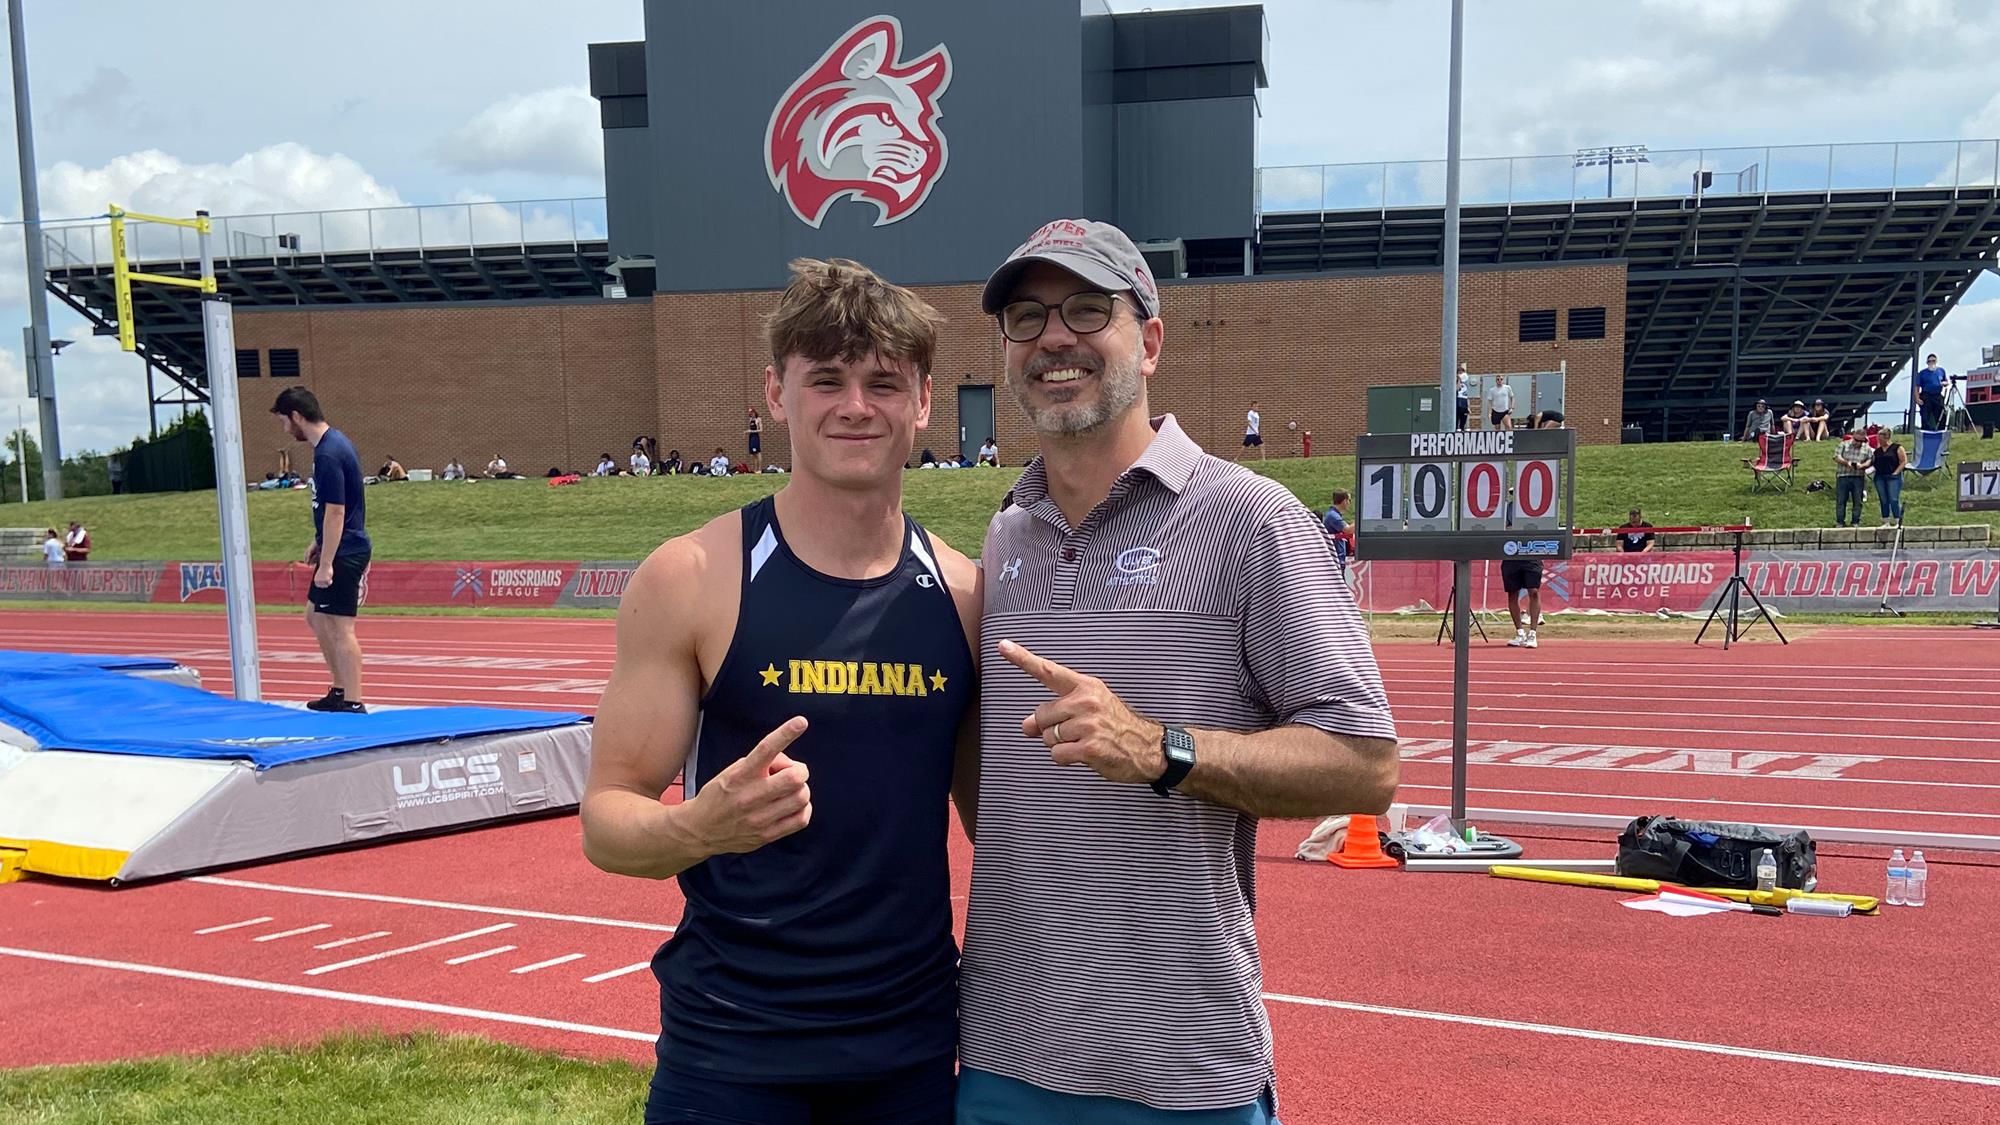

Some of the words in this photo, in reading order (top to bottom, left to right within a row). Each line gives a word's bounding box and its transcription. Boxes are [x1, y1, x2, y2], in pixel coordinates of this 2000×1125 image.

[1026, 220, 1086, 241] ULVER
[1410, 431, 1514, 456] PERFORMANCE
[1517, 540, 1560, 551] UCS
[50, 567, 157, 594] UNIVERSITY
[490, 569, 562, 587] CROSSROADS
[573, 568, 636, 598] INDI
[1583, 562, 1715, 586] CROSSROADS
[1738, 559, 1940, 598] INDIANA
[489, 587, 540, 598] LEAGUE
[1582, 585, 1671, 600] LEAGUE
[788, 659, 928, 697] INDIANA
[393, 752, 501, 795] UCS
[397, 786, 504, 809] WWW.UCSSPIRIT.COM
